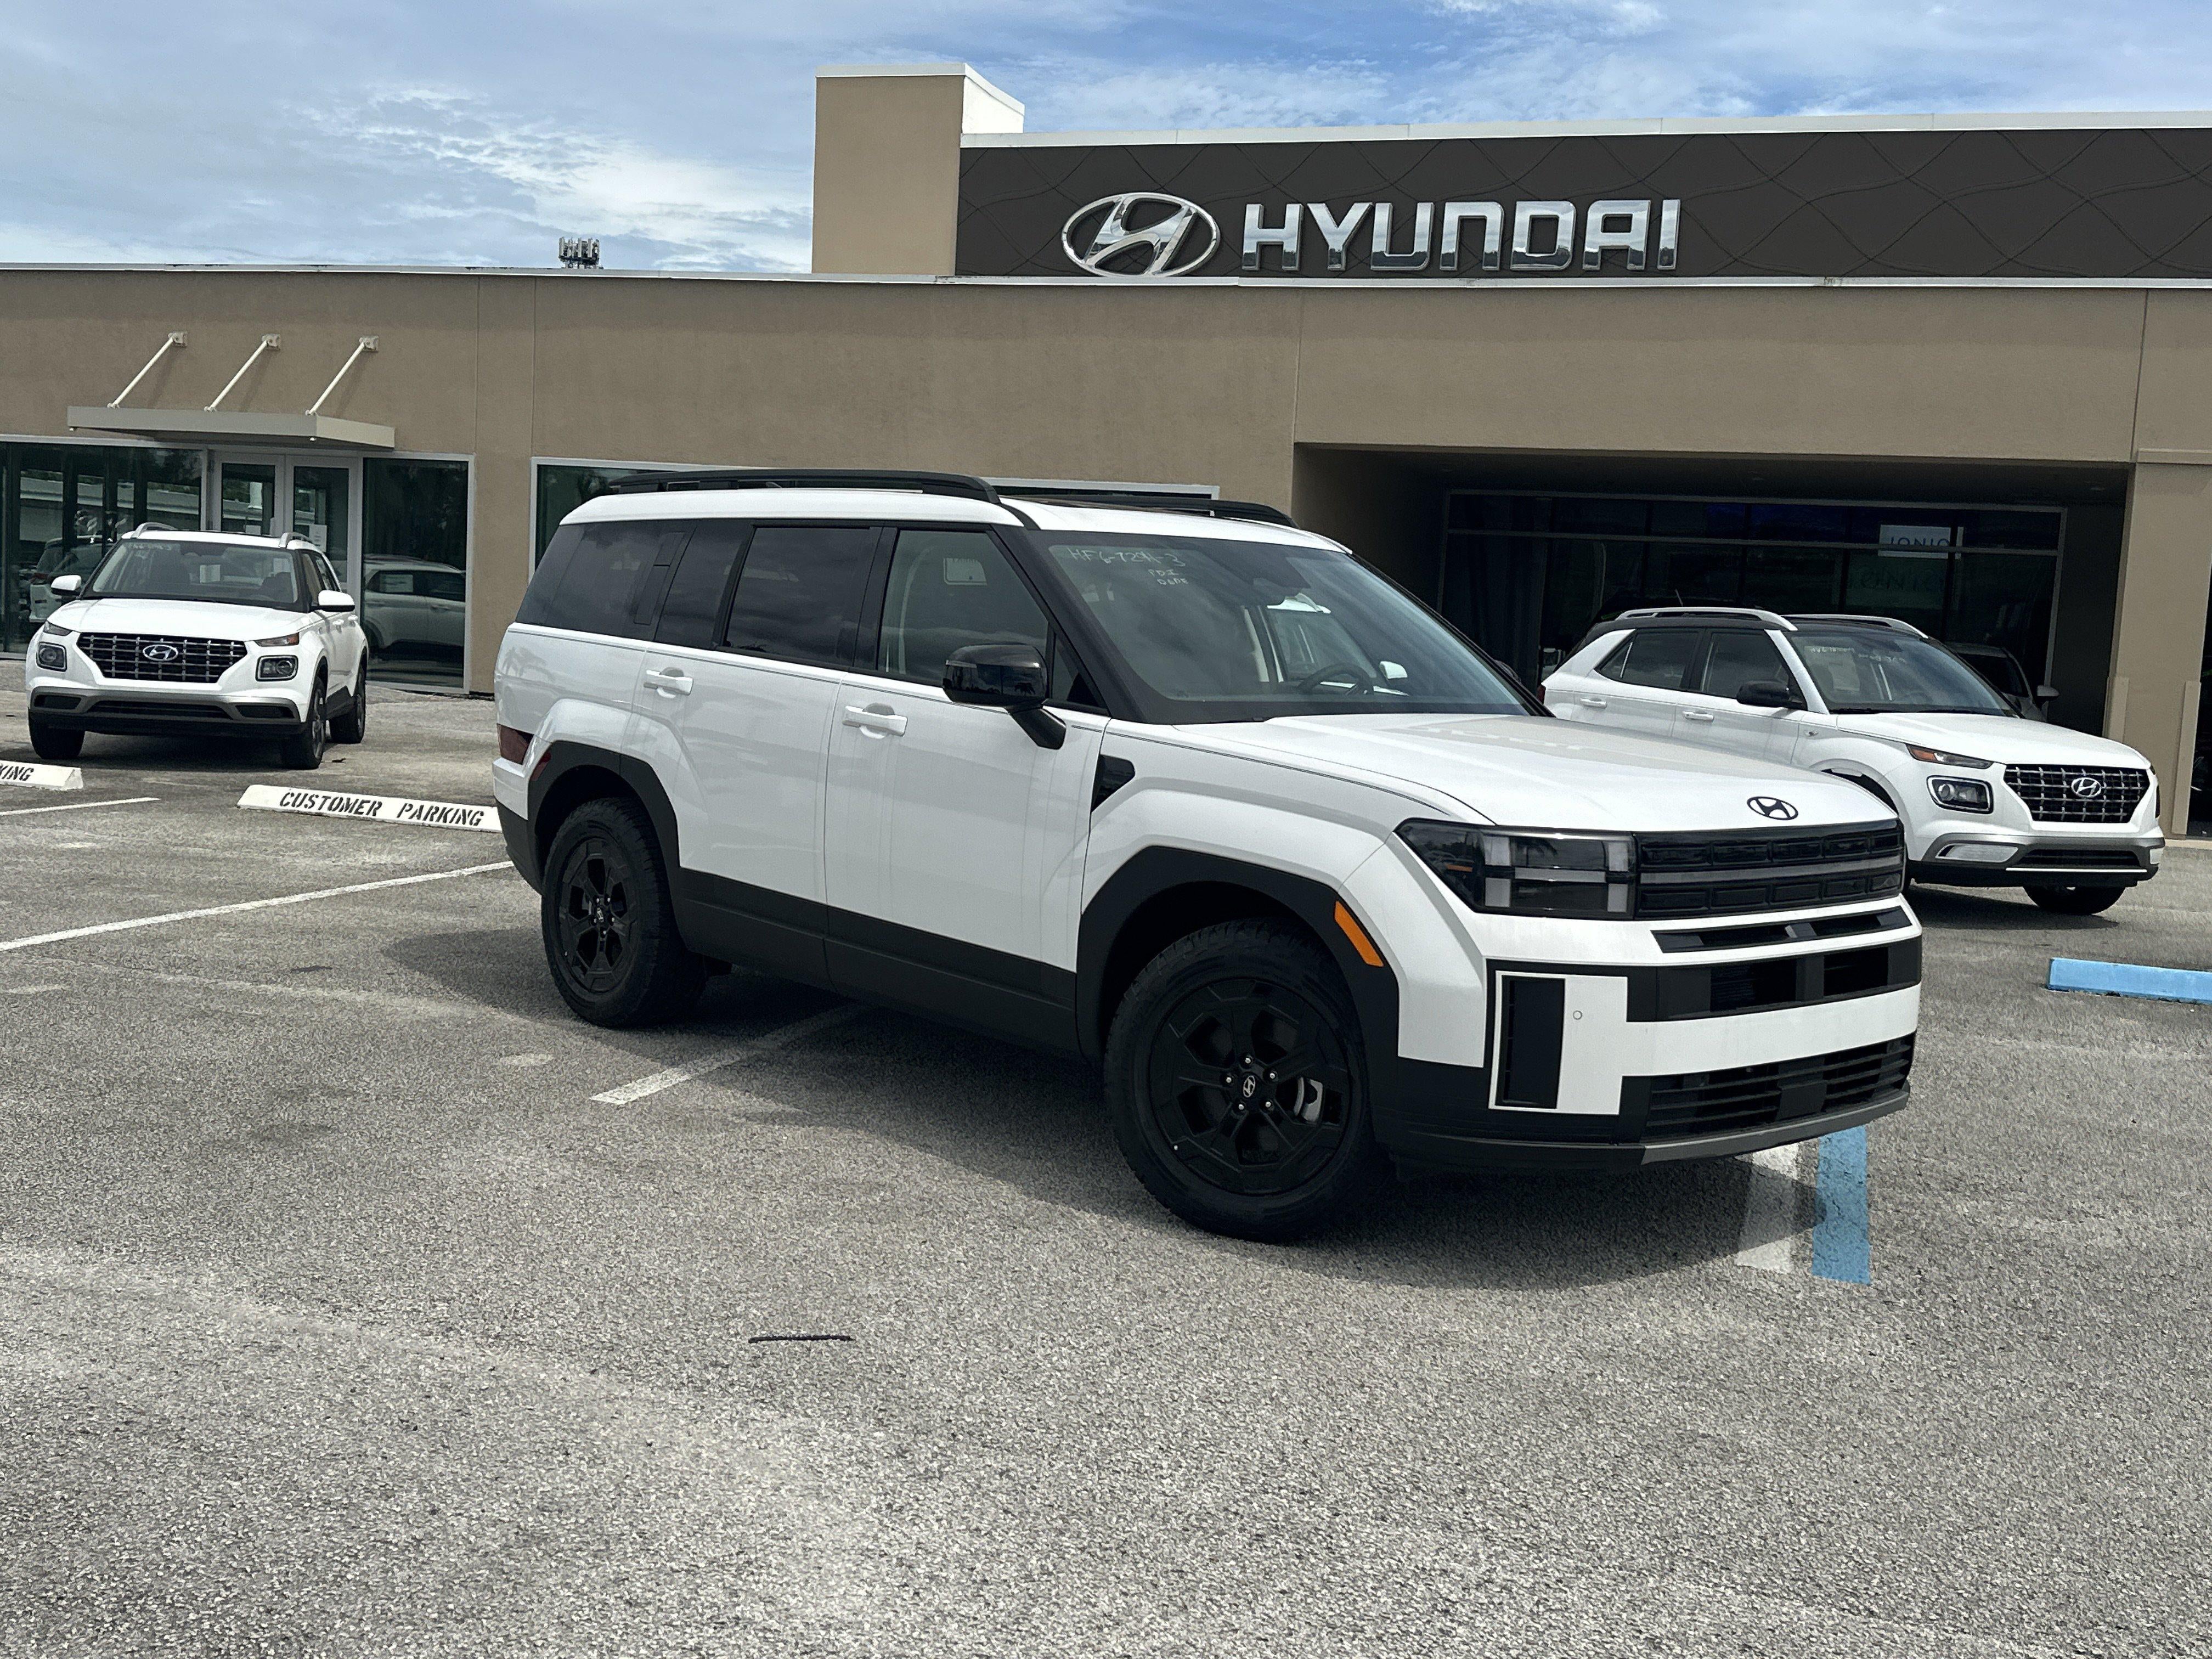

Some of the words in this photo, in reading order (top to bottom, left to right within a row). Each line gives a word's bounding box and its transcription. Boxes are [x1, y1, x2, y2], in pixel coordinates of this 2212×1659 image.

[1241, 199, 1681, 272] HYUNDAI
[279, 792, 382, 816] CUSTOMER
[396, 803, 484, 826] PARKING
